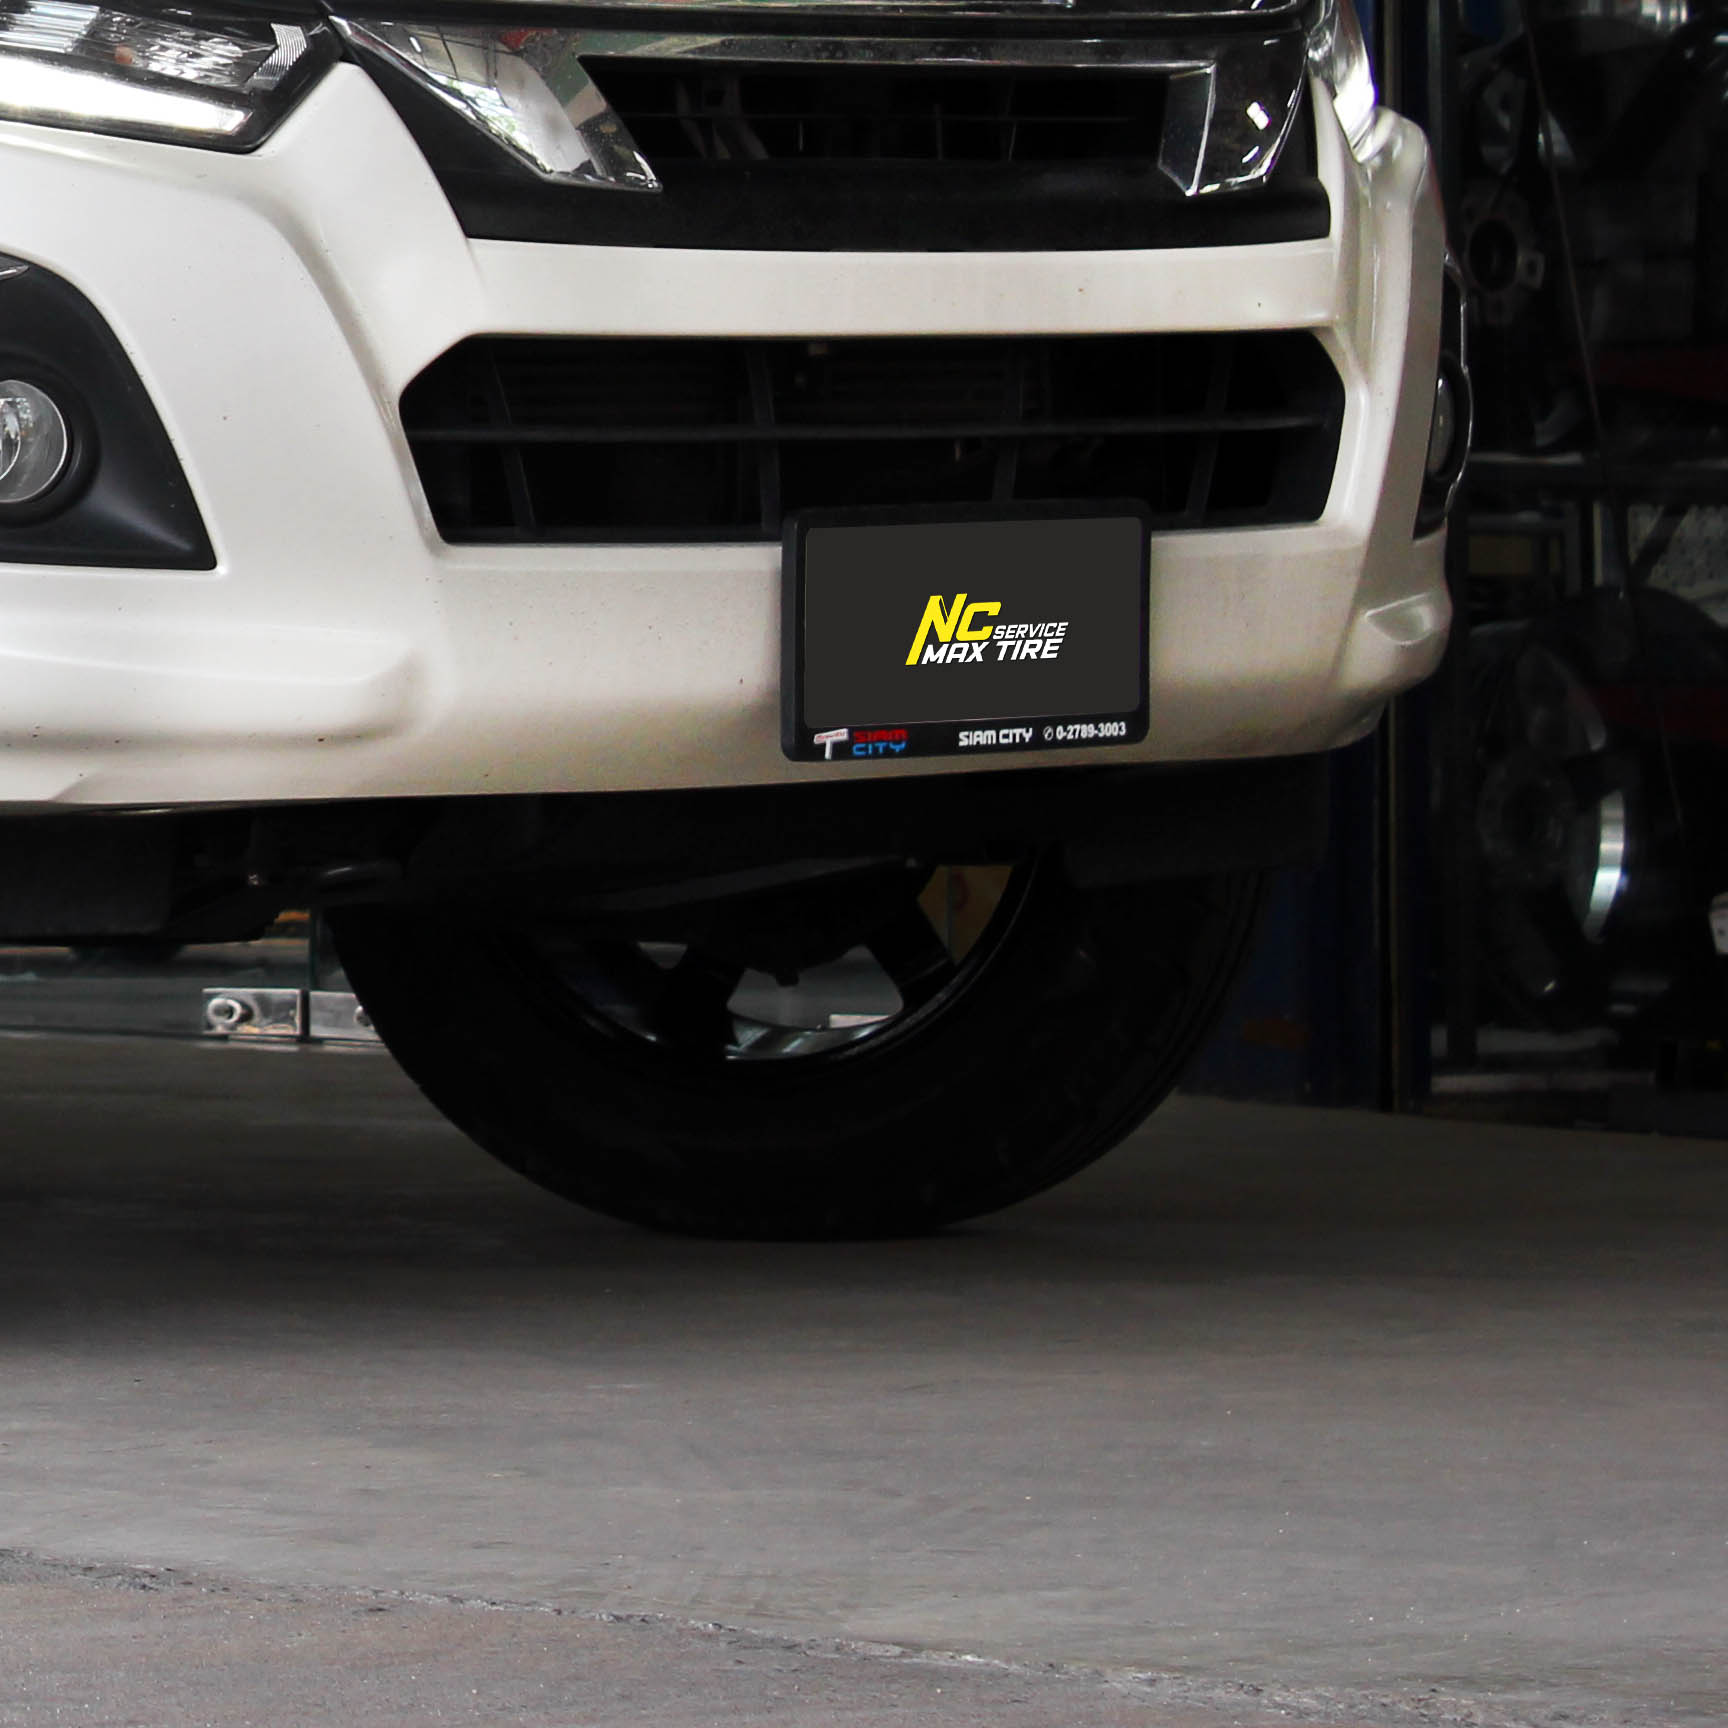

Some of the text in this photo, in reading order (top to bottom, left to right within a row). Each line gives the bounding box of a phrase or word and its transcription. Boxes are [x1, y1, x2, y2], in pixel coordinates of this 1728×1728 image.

[853, 728, 908, 744] SIAM
[958, 721, 1127, 747] SIAM CITY 0-2789-3003
[852, 742, 907, 757] CITY
